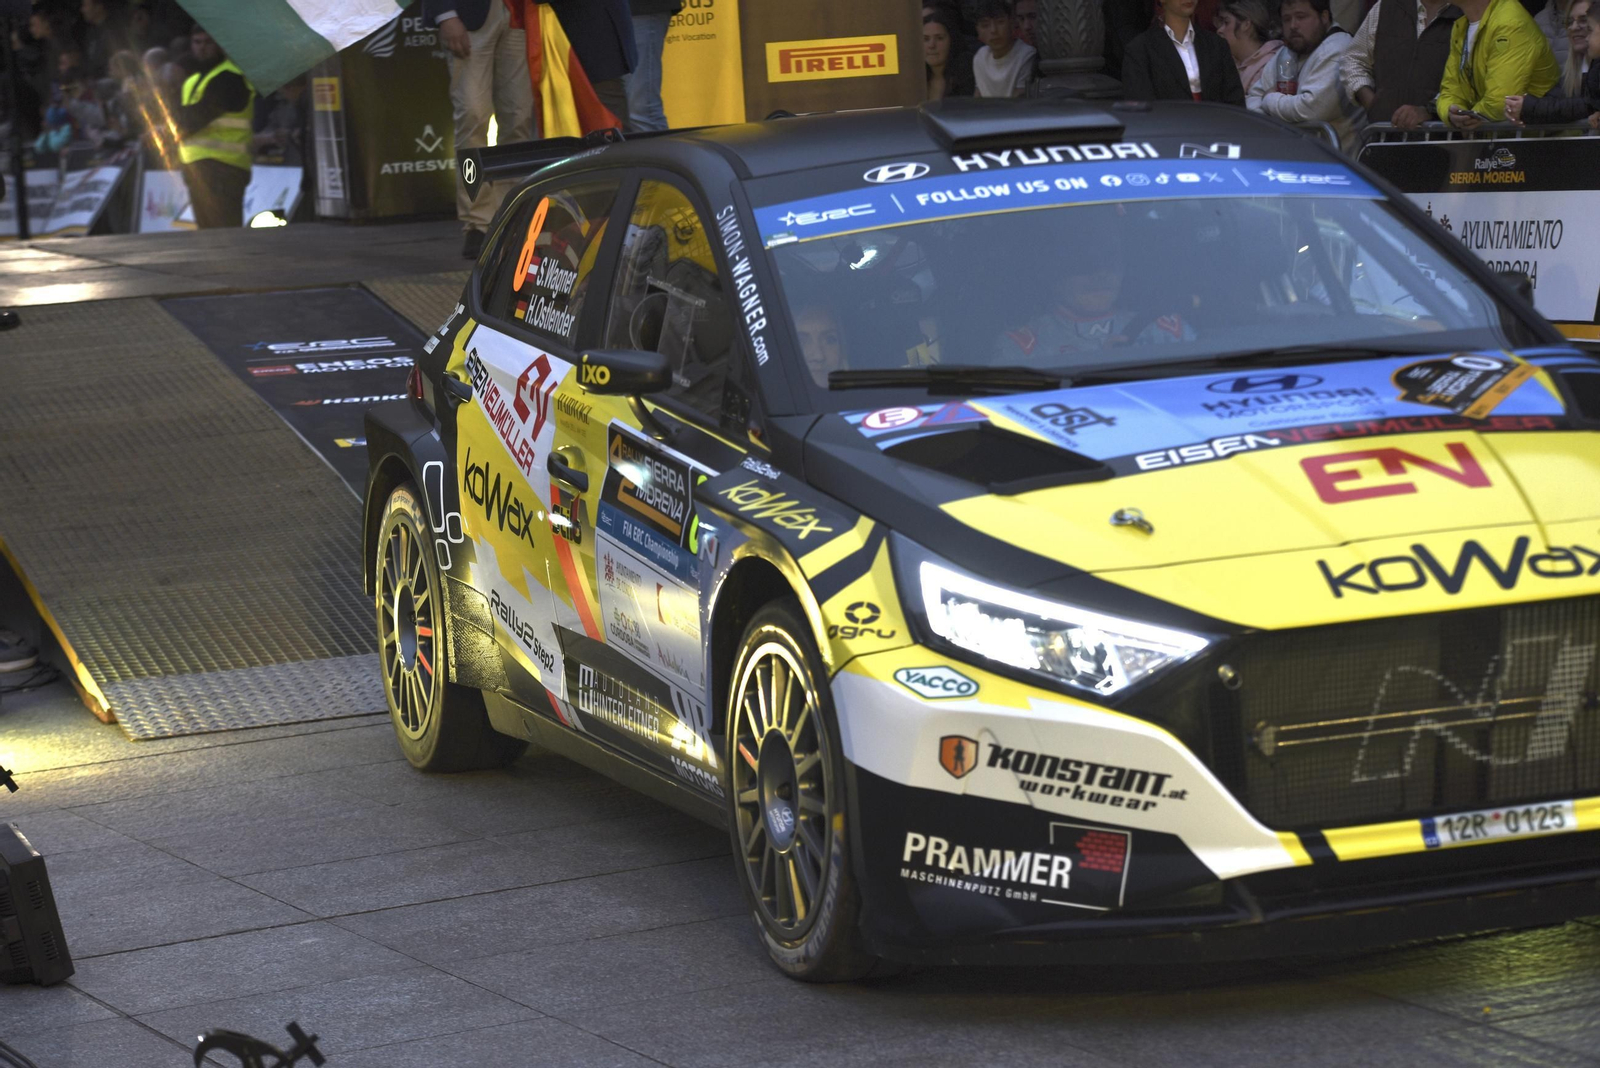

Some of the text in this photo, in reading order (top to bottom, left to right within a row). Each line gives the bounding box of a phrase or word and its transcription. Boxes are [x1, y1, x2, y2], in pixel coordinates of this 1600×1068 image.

[669, 11, 715, 28] GROUP
[404, 34, 437, 47] AERO
[681, 33, 717, 42] Vocation
[778, 42, 886, 75] PIRELLI
[380, 158, 457, 175] ATRESVE
[951, 143, 1159, 172] HYUNDAI
[1475, 158, 1498, 172] Rallye
[916, 183, 1010, 206] FOLLOW
[1015, 180, 1050, 194] US
[1054, 176, 1089, 190] ON
[1449, 171, 1526, 184] SIERRA MORENA
[513, 197, 549, 292] 8
[1460, 219, 1563, 250] AYUNTAMIENTO
[536, 256, 578, 298] S.Wagner
[716, 205, 769, 366] SIMON-WAGNER.com
[525, 294, 576, 338] H.Ostlender
[295, 356, 414, 369] ENEOS
[303, 364, 379, 373] MOTOR
[1201, 387, 1377, 411] HYUNDAI
[644, 455, 685, 496] SIERRA
[463, 447, 535, 549] koWax
[635, 482, 684, 523] MORENA
[718, 479, 833, 540] koWax
[622, 520, 632, 537] FIA
[632, 527, 644, 546] ERC
[644, 533, 679, 570] Championship
[490, 589, 535, 649] Rally2
[827, 624, 896, 640] agru
[905, 670, 972, 695] YACCO
[593, 691, 660, 744] HINTERLEITNER
[1018, 779, 1158, 812] workwear
[1442, 814, 1487, 841] 12R
[1505, 804, 1565, 832] 0125
[902, 831, 1073, 890] PRAMMER
[900, 868, 1038, 902] MASCHINENPUTZ GmbH
